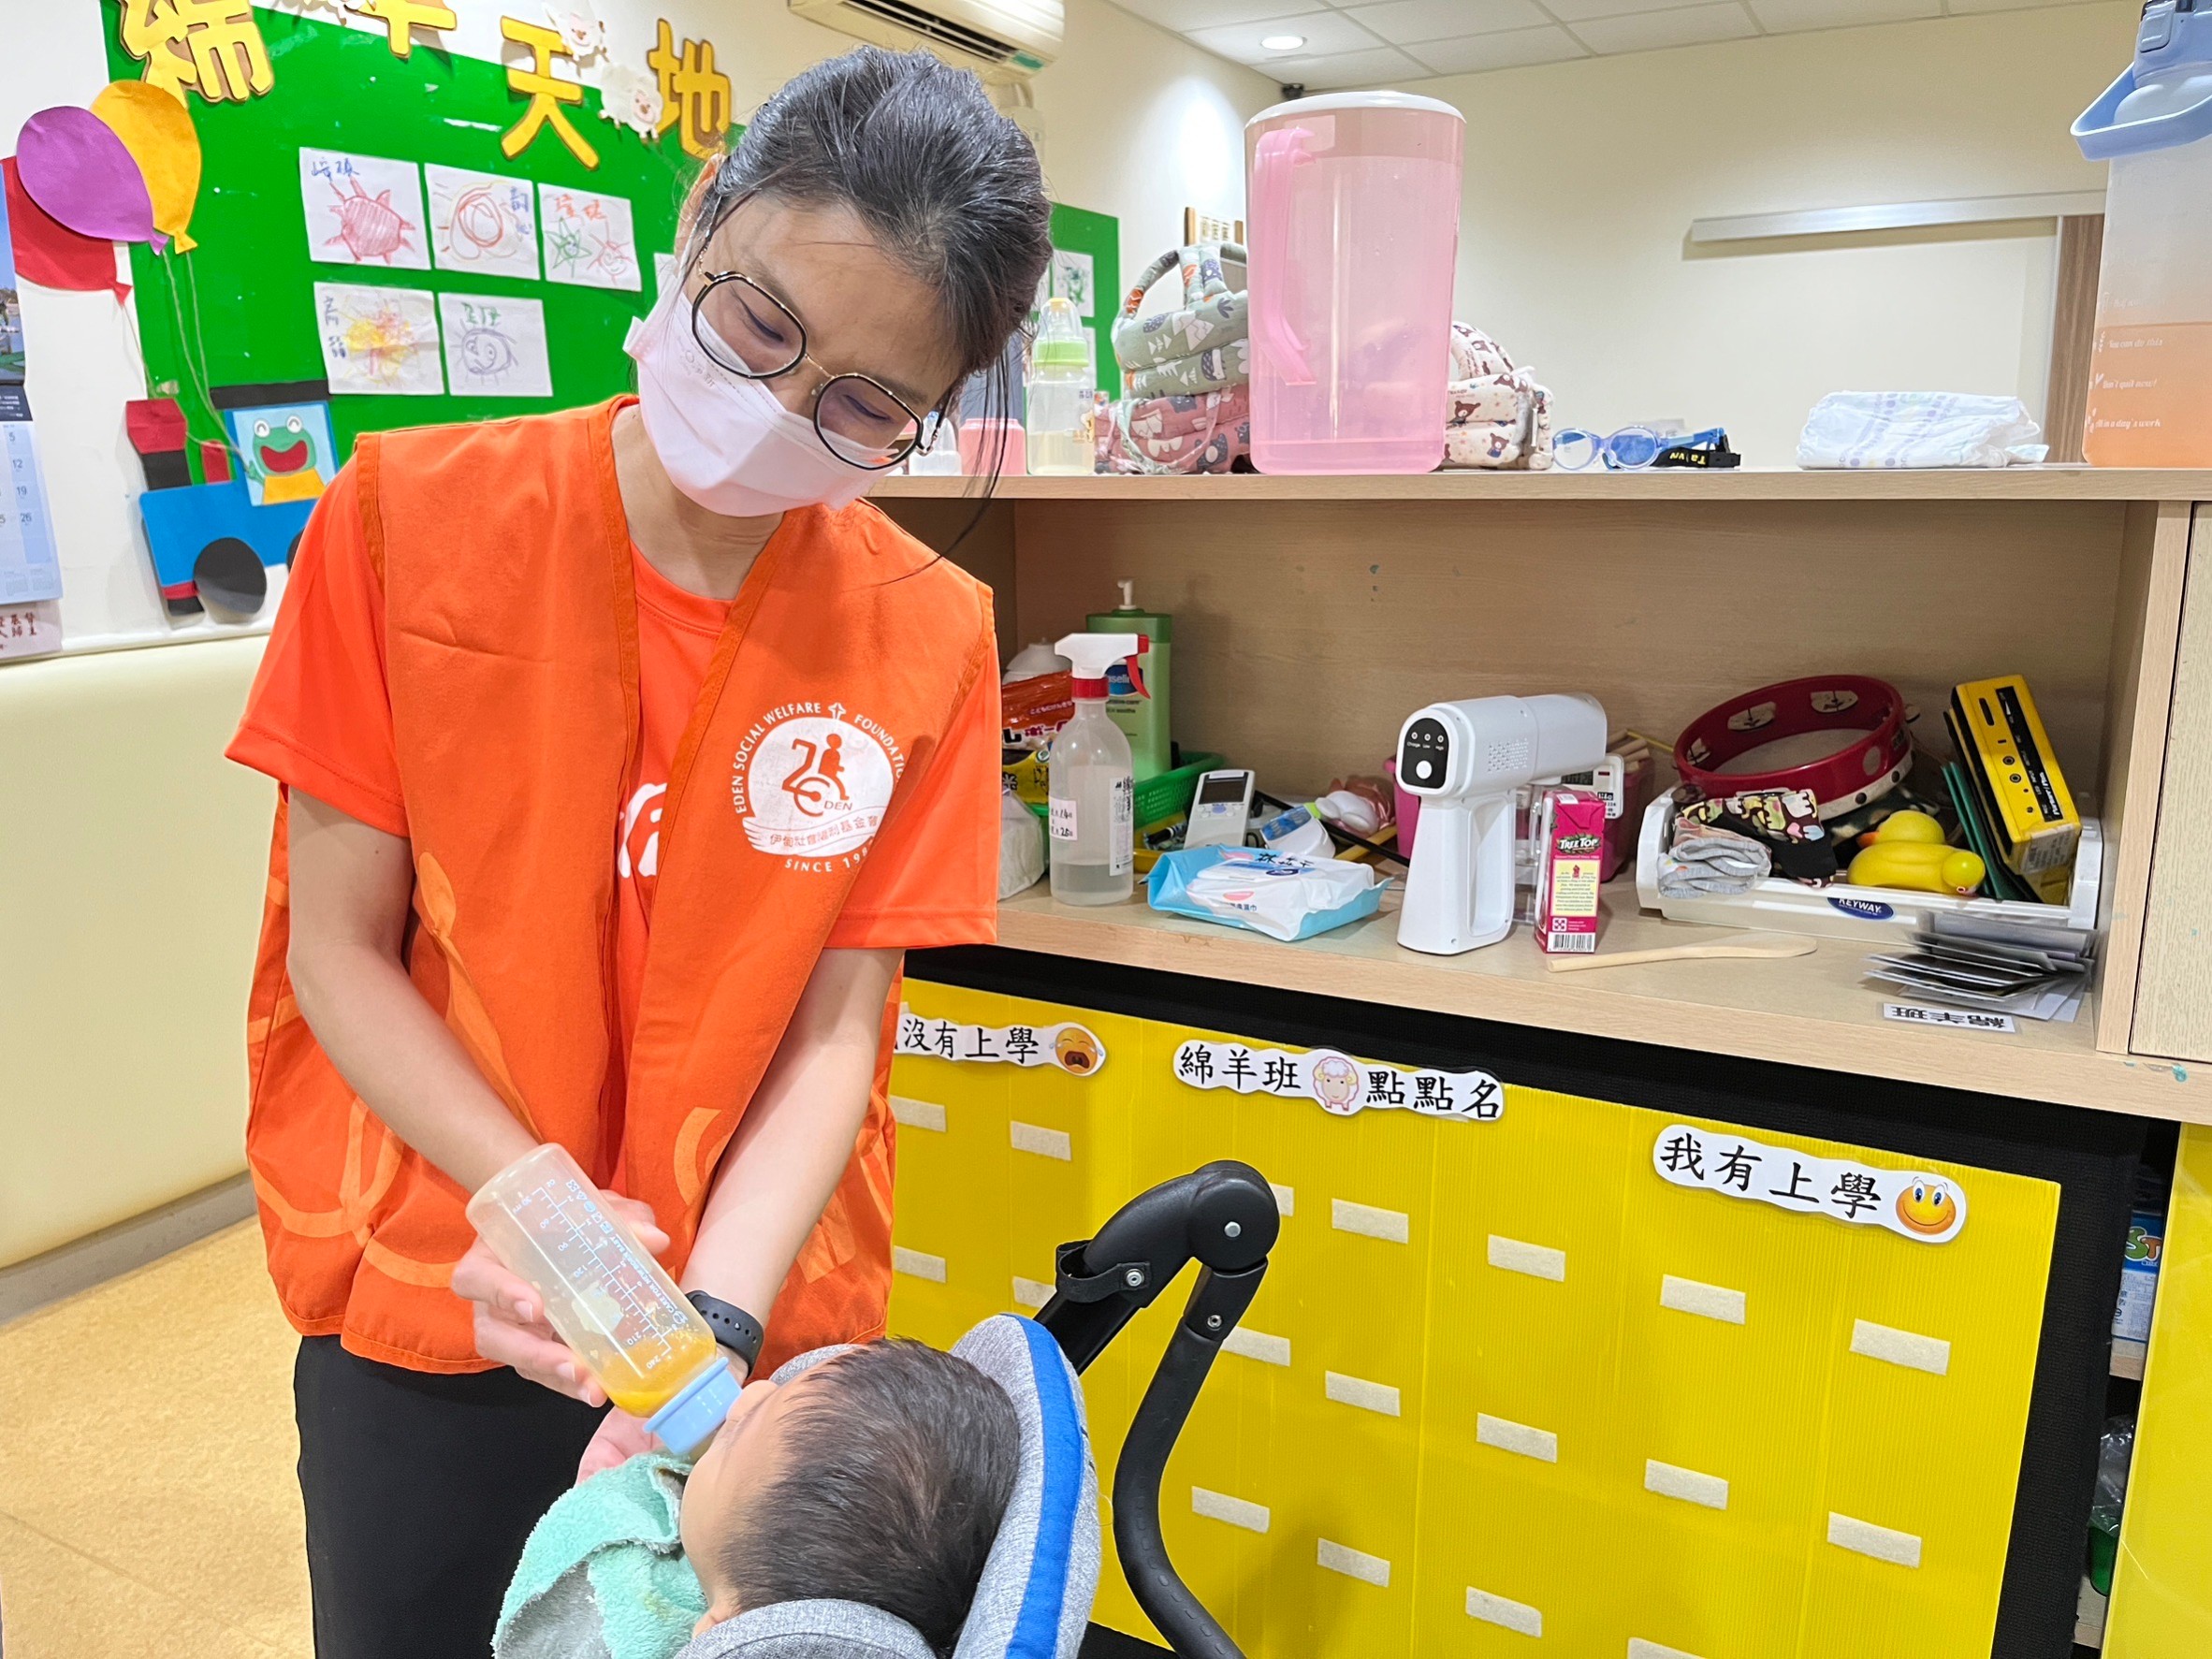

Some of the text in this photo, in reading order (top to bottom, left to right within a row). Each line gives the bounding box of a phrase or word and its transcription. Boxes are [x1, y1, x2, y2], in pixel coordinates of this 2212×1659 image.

[2138, 418, 2161, 428] work
[8, 431, 16, 442] 5
[12, 458, 23, 469] 12
[16, 486, 27, 496] 19
[20, 512, 33, 523] 26
[732, 702, 907, 814] EDEN SOCIAL WELFARE FOUNDATIO
[784, 858, 832, 873] SINCE
[1839, 897, 1882, 914] KEYWAY
[1891, 1006, 2006, 1028] 綿羊班
[895, 1016, 1040, 1066] 沒有上學
[1179, 1043, 1501, 1120] 綿羊班 點點名
[1659, 1132, 1882, 1219] 我有上學
[539, 1218, 550, 1229] 60
[558, 1242, 569, 1252] 90
[574, 1264, 588, 1278] 120
[649, 1284, 661, 1299] FOR
[627, 1331, 642, 1346] 210
[646, 1354, 662, 1369] 240
